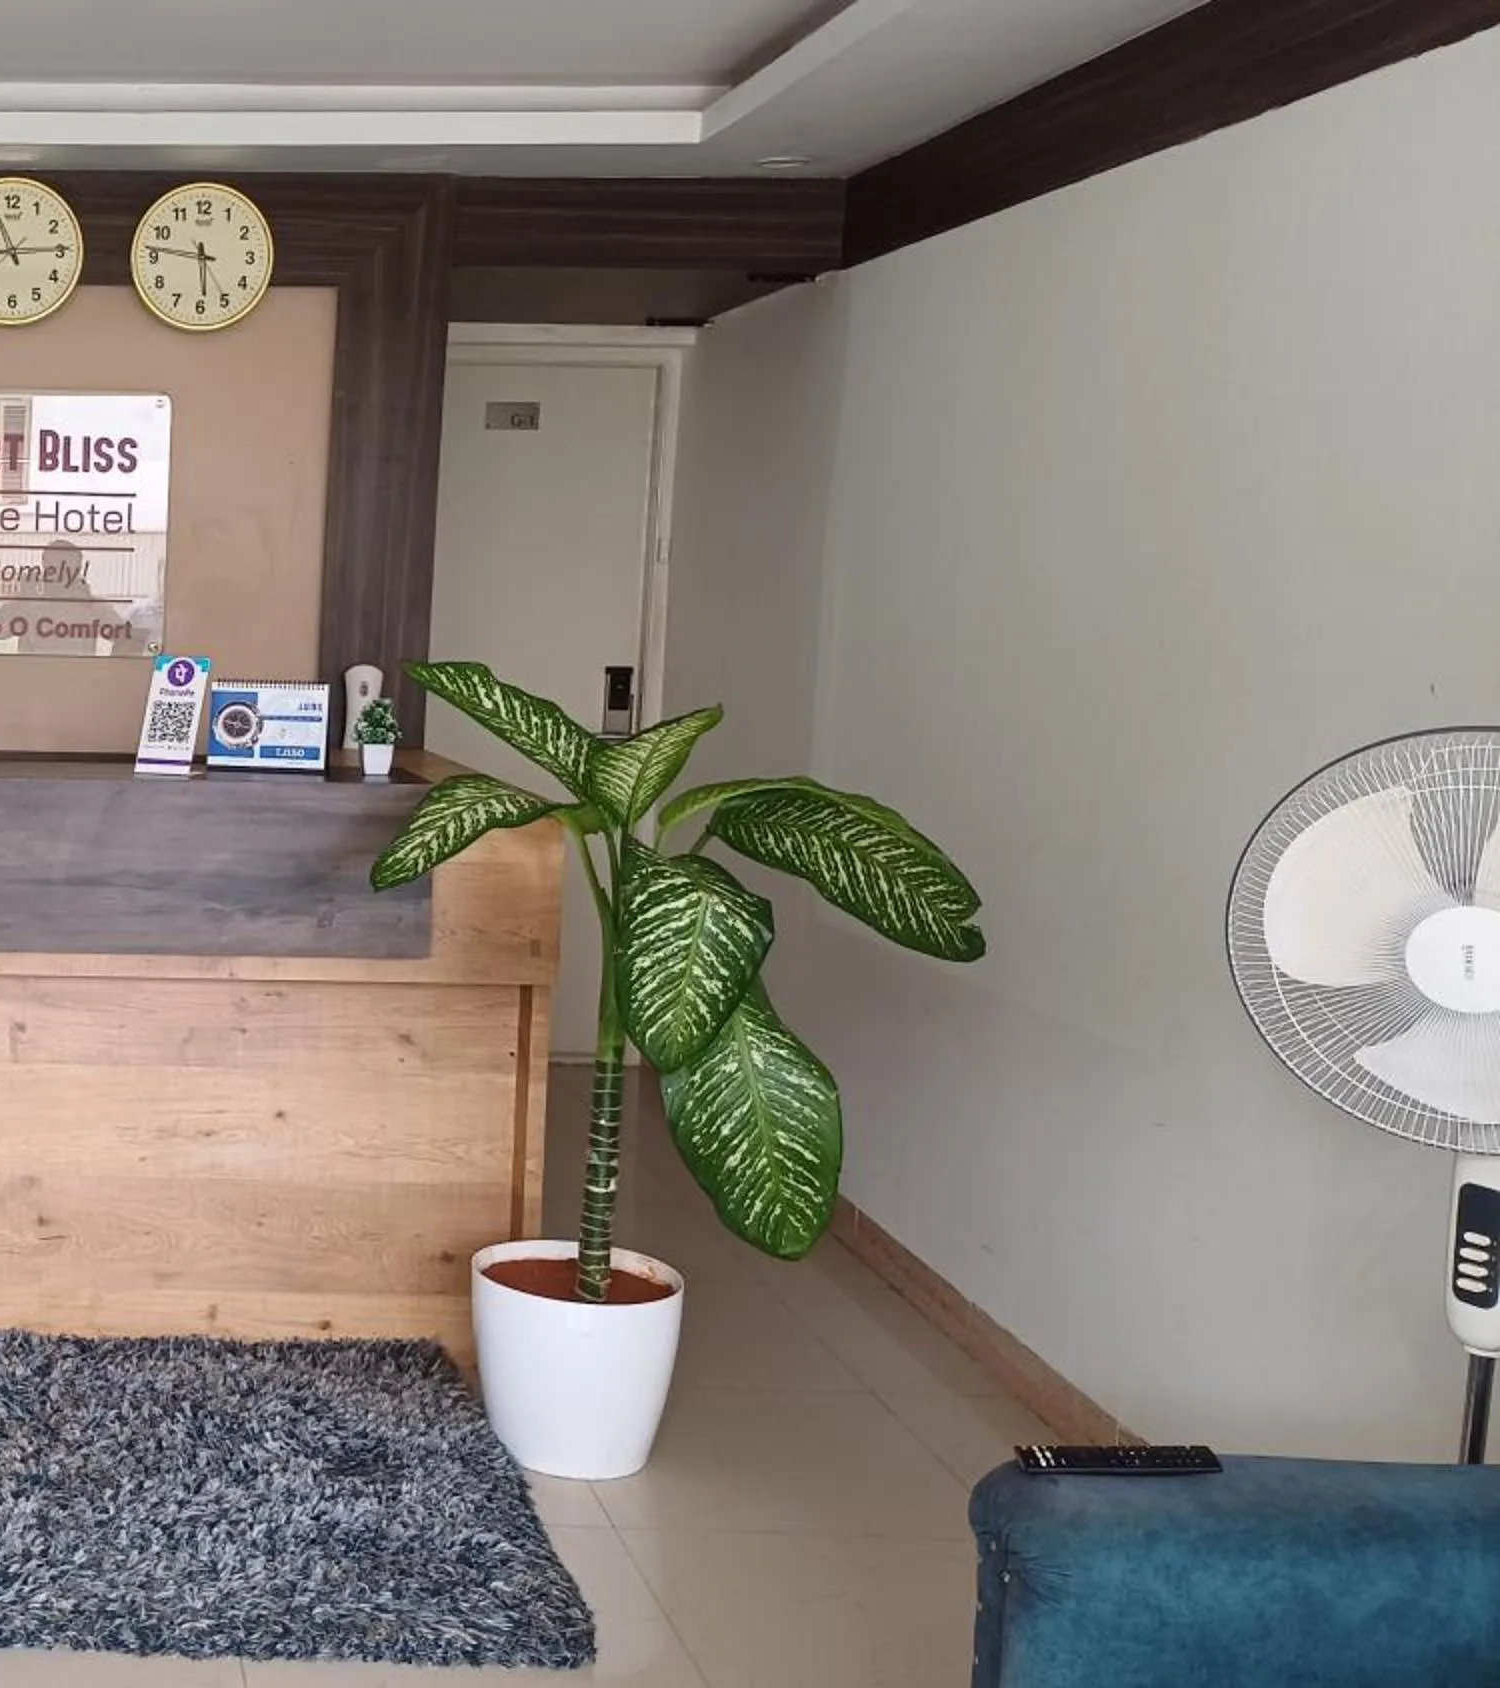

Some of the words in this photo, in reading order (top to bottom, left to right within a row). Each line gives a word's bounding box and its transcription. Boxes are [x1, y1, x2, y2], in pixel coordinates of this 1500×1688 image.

[4, 195, 20, 209] 12
[33, 202, 40, 215] 1
[195, 200, 212, 215] 12
[173, 207, 187, 221] 11
[224, 208, 231, 222] 1
[49, 219, 59, 234] 2
[154, 225, 171, 240] 10
[239, 225, 249, 240] 2
[55, 244, 65, 258] 3
[148, 250, 159, 264] 9
[245, 251, 255, 265] 3
[49, 269, 59, 283] 4
[155, 275, 165, 289] 8
[238, 275, 247, 290] 4
[31, 288, 41, 301] 5
[172, 293, 181, 307] 7
[220, 293, 229, 308] 5
[7, 295, 17, 309] 6
[195, 300, 205, 314] 6
[38, 429, 139, 474] BLISS
[35, 501, 136, 534] Hotel
[9, 617, 28, 638] O
[37, 618, 133, 641] Comfort
